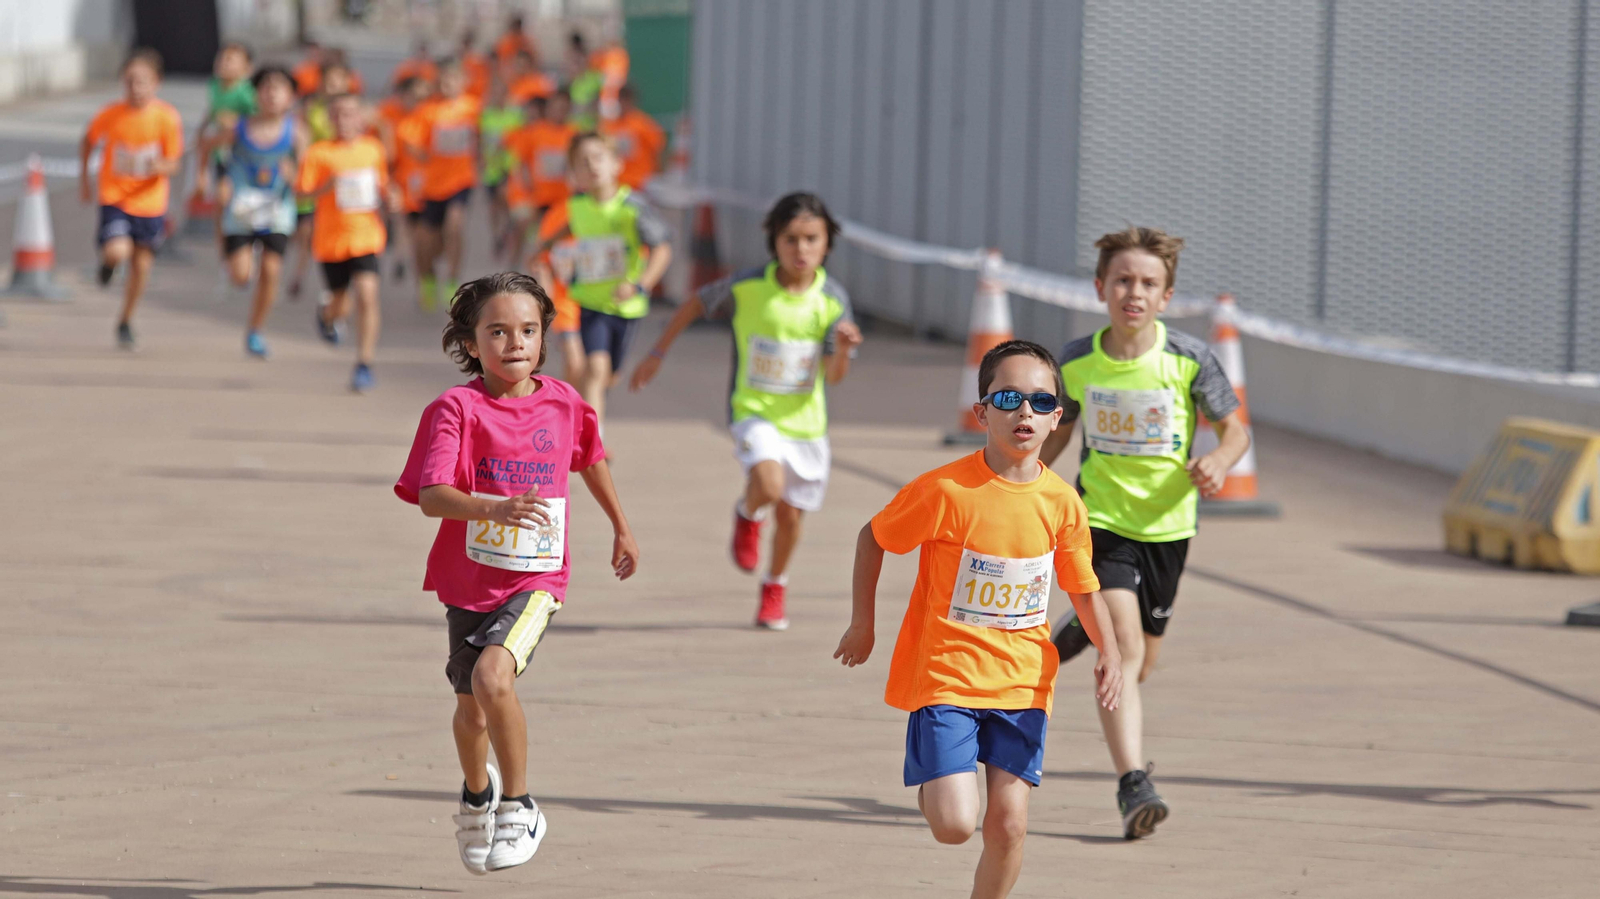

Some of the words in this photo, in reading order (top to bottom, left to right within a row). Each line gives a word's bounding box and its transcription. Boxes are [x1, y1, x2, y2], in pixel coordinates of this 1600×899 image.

[1097, 410, 1136, 435] 884
[478, 457, 555, 474] ATLETISMO
[476, 468, 554, 485] INMACULADA
[475, 520, 519, 549] 231
[970, 558, 986, 571] XX
[985, 561, 1005, 569] Carrera
[984, 566, 1005, 575] Popular
[965, 578, 1028, 608] 1037
